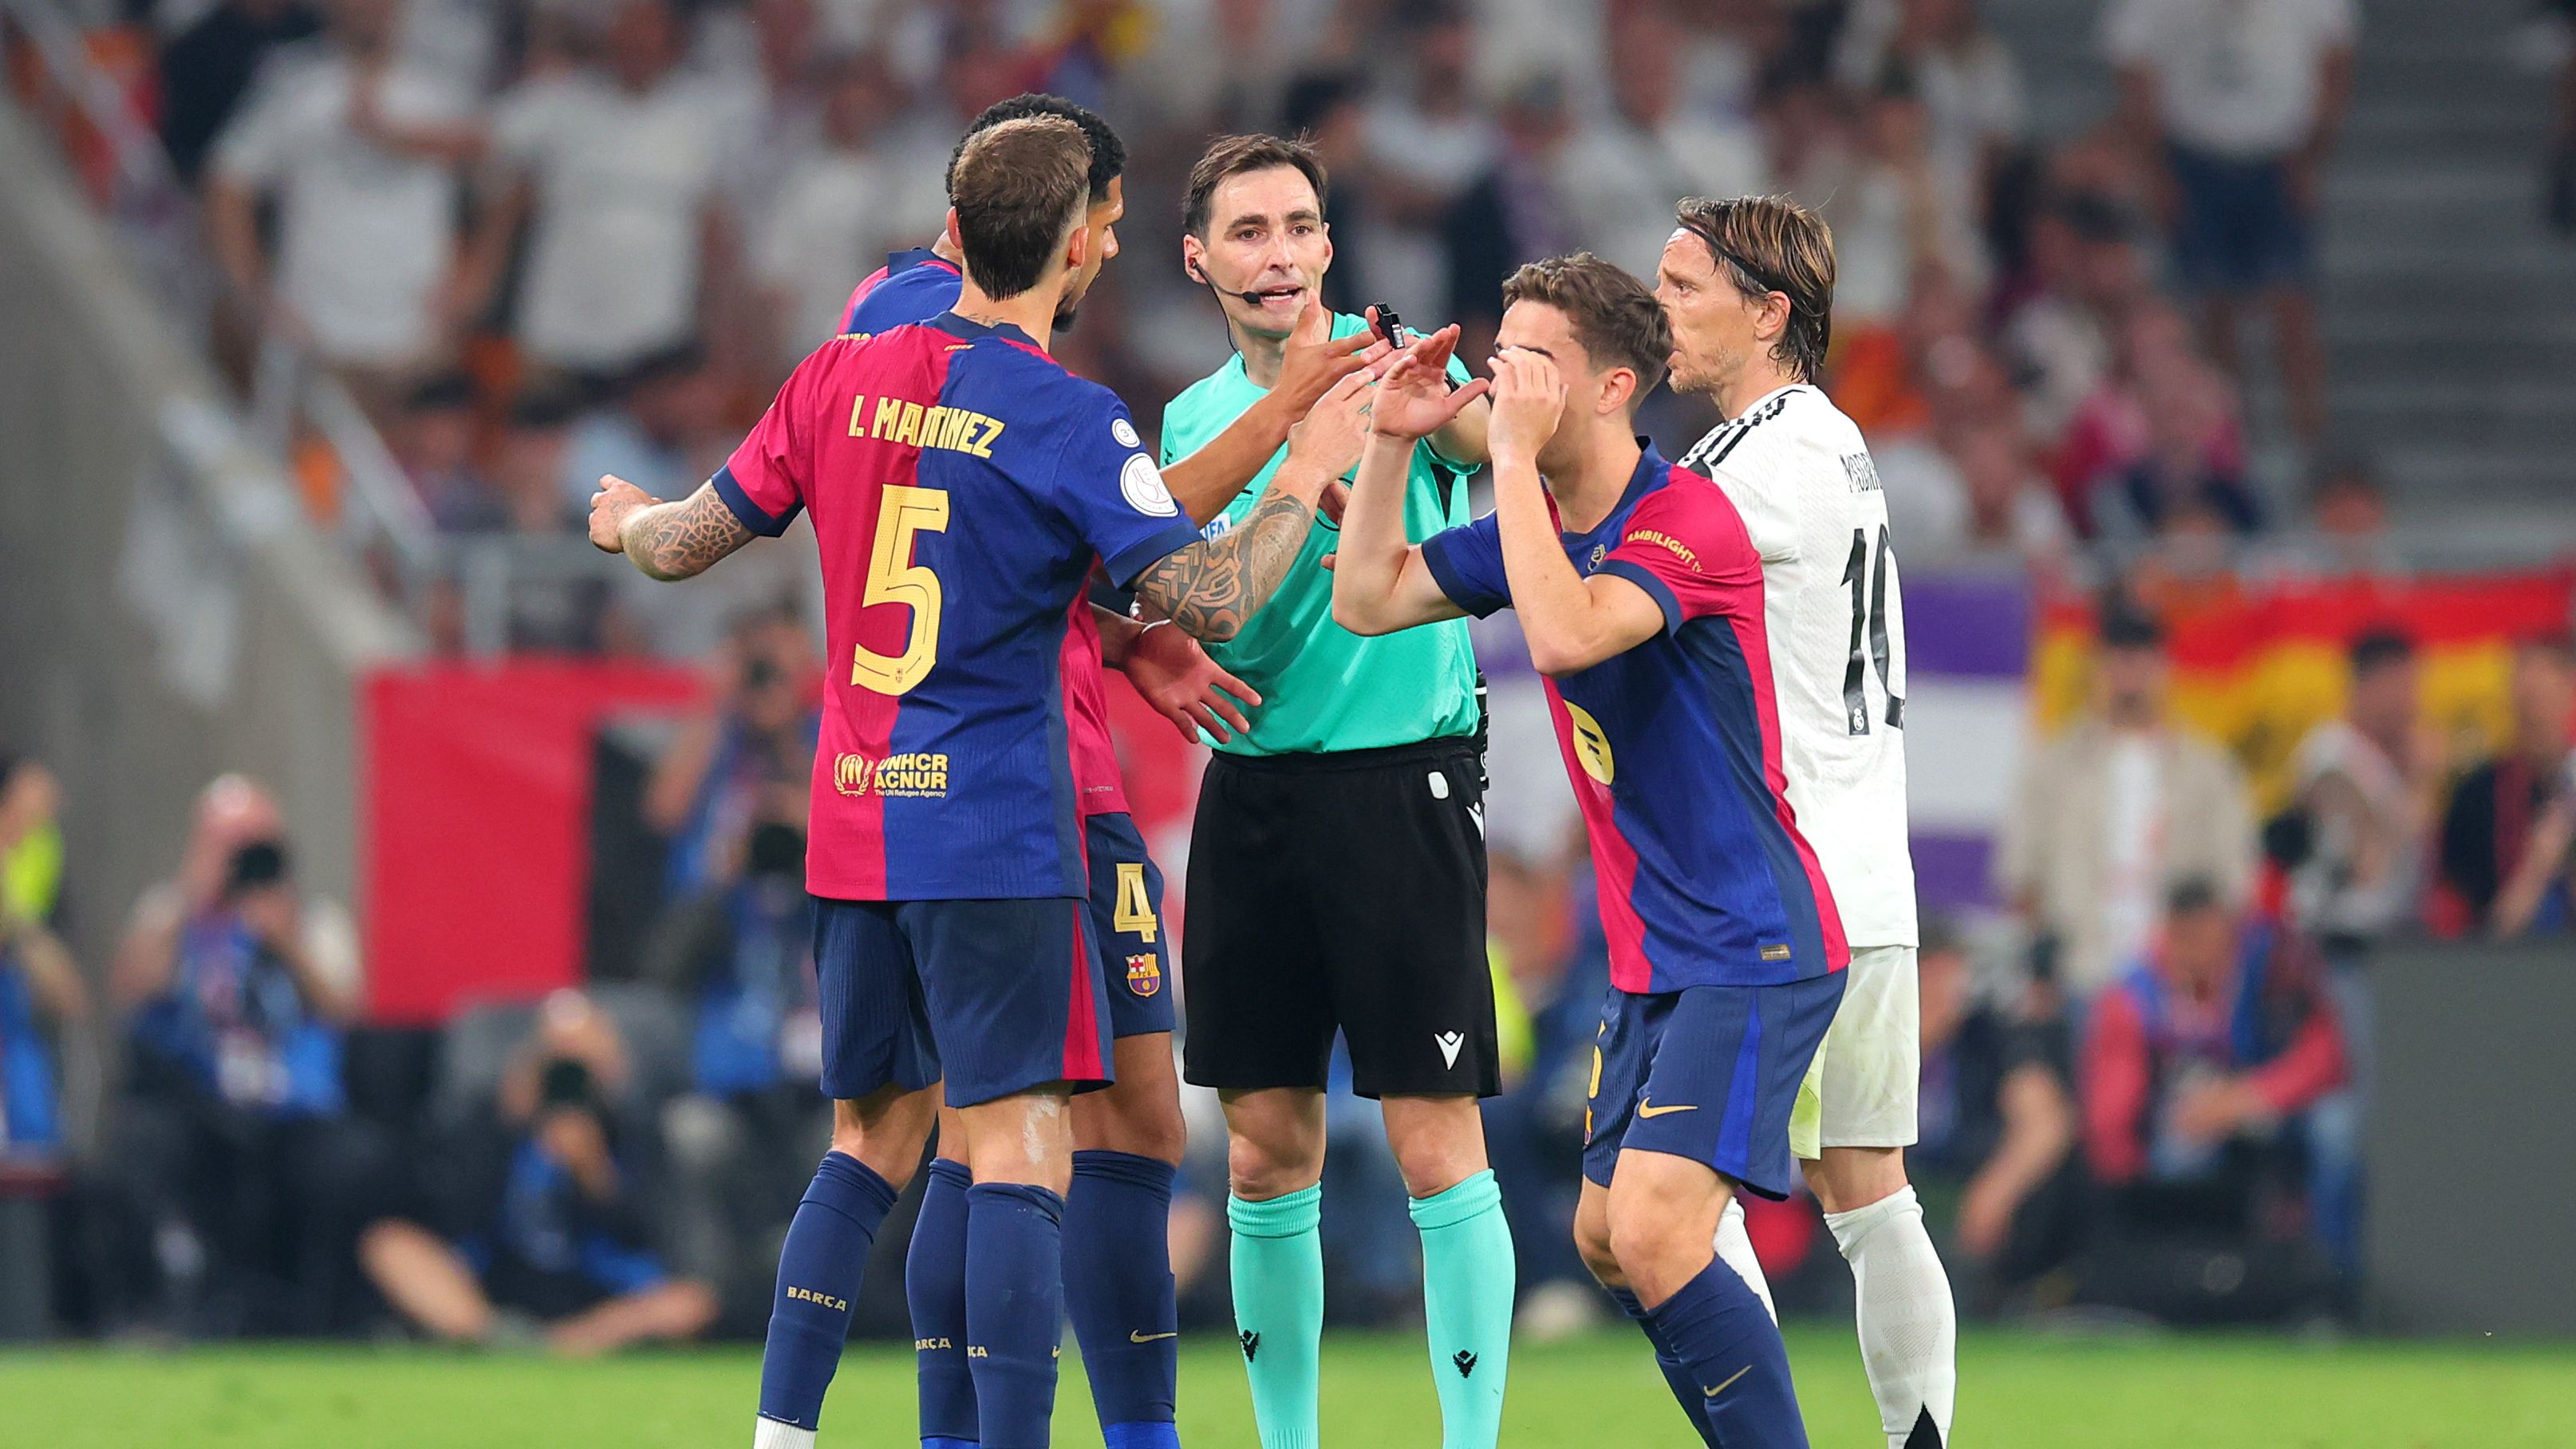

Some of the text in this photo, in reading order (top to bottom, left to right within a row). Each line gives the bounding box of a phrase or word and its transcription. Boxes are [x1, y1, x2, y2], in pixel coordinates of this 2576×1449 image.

[848, 395, 865, 437] I.
[1839, 452, 1883, 493] MODRI
[1627, 530, 1696, 563] AMBILIGHT
[850, 484, 950, 697] 5
[1840, 523, 1905, 736] 10
[874, 771, 947, 789] ACNUR
[876, 752, 949, 772] UNHCR
[1114, 863, 1158, 943] 4
